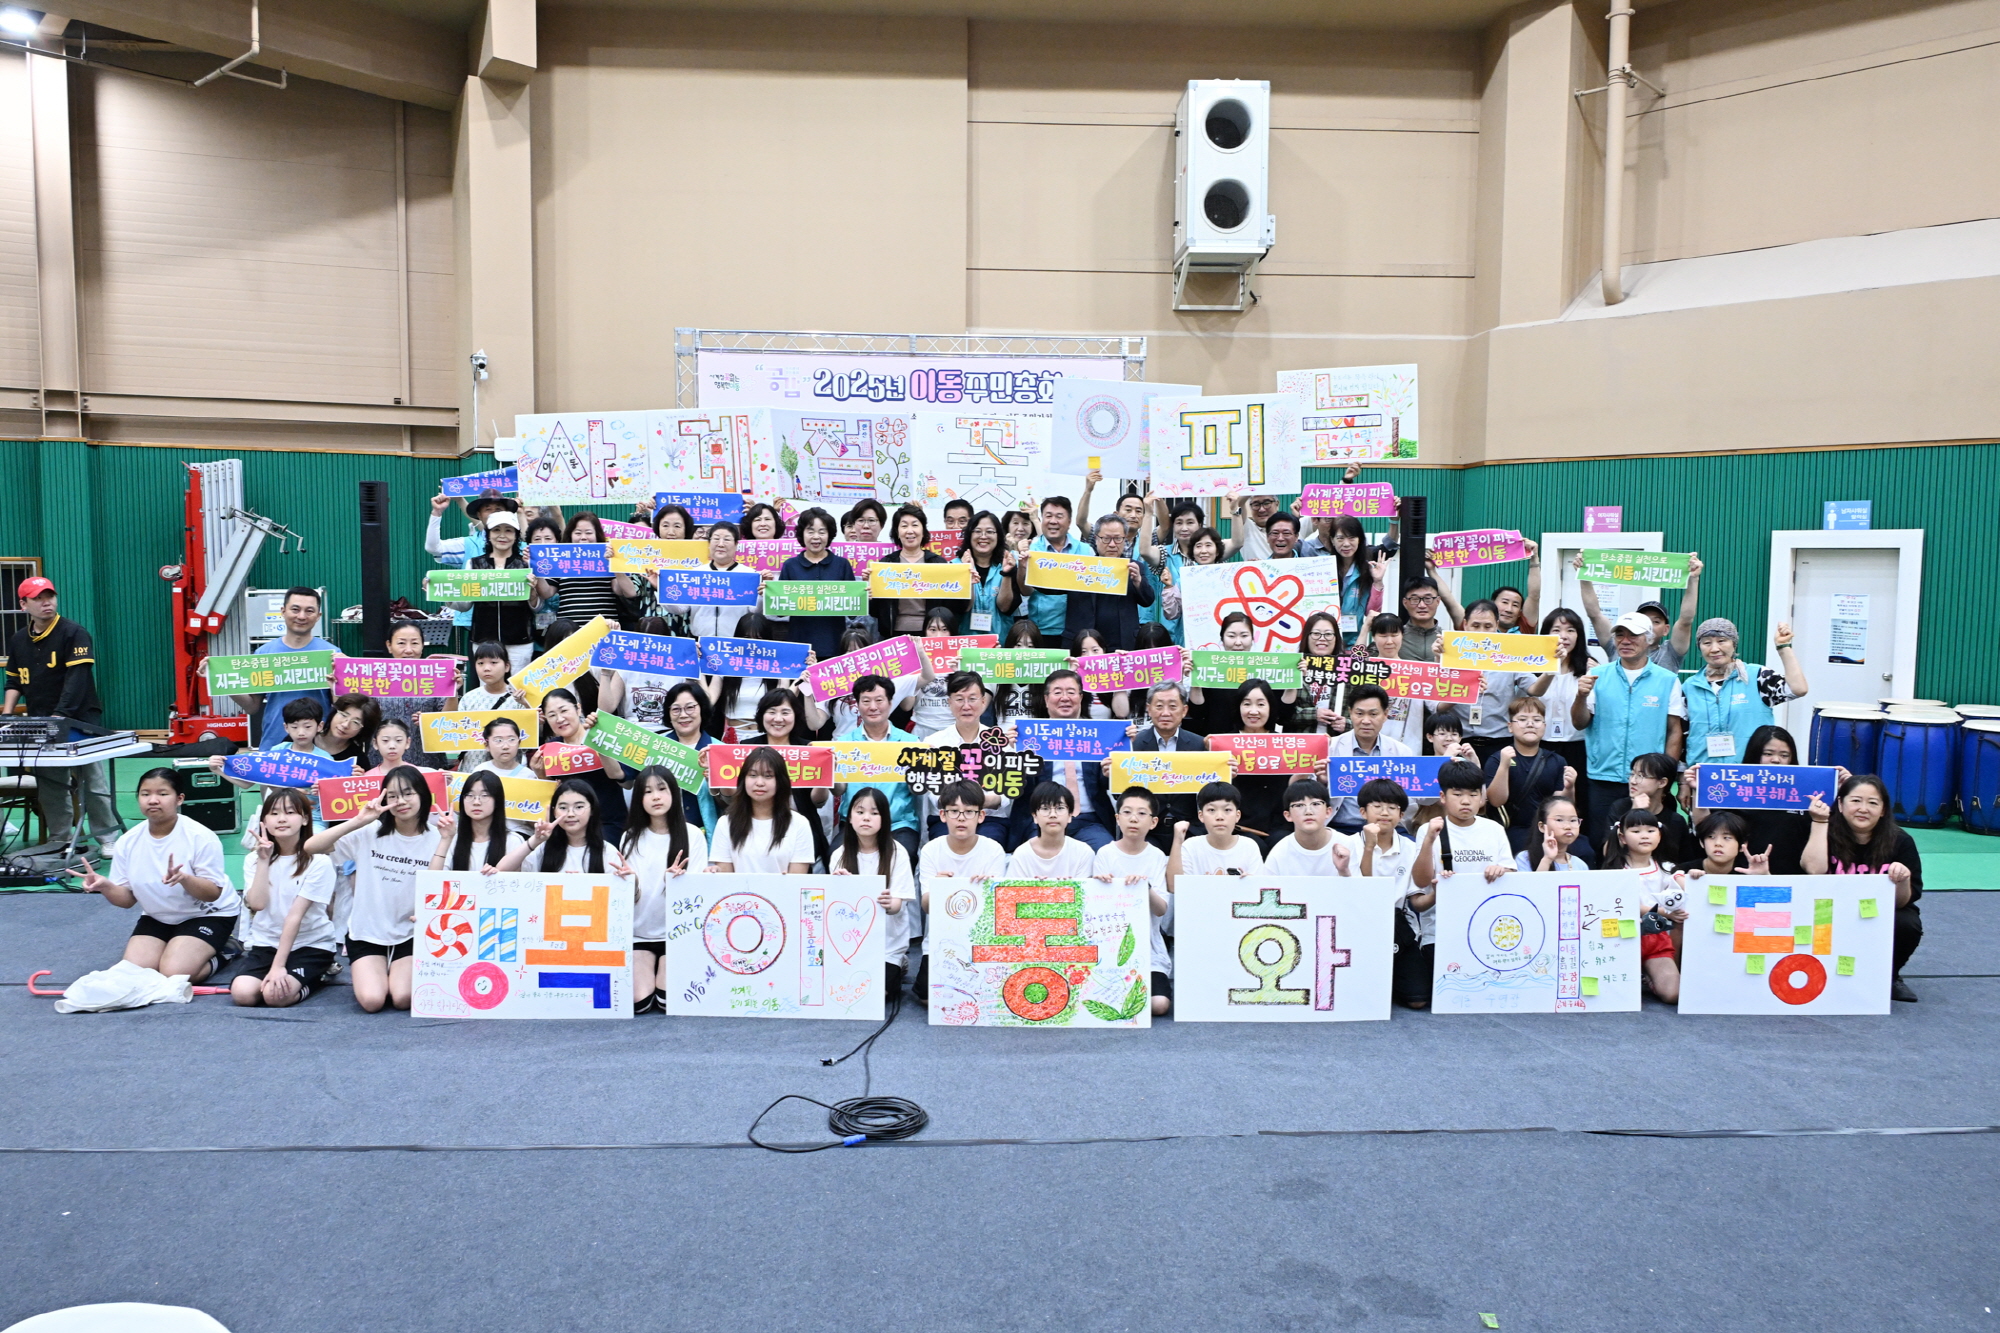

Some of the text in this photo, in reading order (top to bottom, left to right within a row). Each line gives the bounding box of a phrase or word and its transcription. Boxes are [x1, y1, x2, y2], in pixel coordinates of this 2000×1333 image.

[814, 368, 905, 402] 2025년
[1303, 374, 1382, 460] 는
[1180, 403, 1265, 486] 피
[536, 420, 616, 498] 사
[678, 415, 754, 499] 계
[801, 418, 877, 499] 절
[947, 417, 1028, 507] 꽃
[693, 496, 719, 507] 살아서
[1308, 486, 1391, 502] 사계절꽃이 피는
[1307, 499, 1380, 515] 행복한 이동
[1432, 532, 1515, 551] 사계절꽃이 피는
[538, 547, 600, 562] 이동에 살아서
[1431, 545, 1506, 566] 행복한 이동
[1600, 553, 1668, 564] 탄소중립 실천으로
[447, 571, 510, 580] 탄소중립 실천으로
[668, 573, 730, 588] 이동에 살아서
[1584, 564, 1682, 582] 지구는 이동이 지킨다!!
[434, 581, 525, 597] 지구는 이동이 지킨다!!
[687, 587, 755, 601] 행복해요~^^
[783, 584, 846, 594] 탄소중립 실천으로
[770, 596, 861, 611] 지구는 이동이 지킨다!!
[603, 635, 672, 654] 이동에 살아서
[708, 640, 776, 657] 이동에 살아서
[46, 651, 56, 668] J
[231, 656, 309, 669] 탄소중립 실천으로
[623, 652, 696, 671] 행복해요~^^
[728, 656, 801, 673] 행복해요~^^
[818, 639, 909, 679] 사계절꽃이 피는
[980, 652, 1046, 660] 탄소중립 실천으로
[1084, 653, 1174, 674] 사계절꽃이 피는
[1211, 655, 1279, 665] 탄소중립 실천으로
[215, 668, 328, 689] 지구는 이동이 지킨다!!
[344, 663, 447, 682] 사계절꽃이 피는
[995, 663, 1022, 678] 이동이
[1197, 667, 1224, 682] 지구는
[1255, 669, 1294, 684] 지킨다!!
[1390, 663, 1460, 678] 안산의 번영은
[343, 678, 434, 695] 행복한 이동
[1084, 672, 1124, 689] 행복한
[1436, 680, 1468, 698] 부터
[615, 722, 688, 759] 탄소중립 실천으로
[1025, 723, 1098, 741] 이동에 살아서
[591, 729, 654, 766] 지구는 이동이
[1047, 738, 1124, 757] 행복해요~^^
[1233, 736, 1307, 749] 안산의 번영은
[284, 751, 319, 767] 살아서
[898, 750, 956, 771] 사계절
[1340, 760, 1416, 777] 이동에 살아서
[983, 771, 1024, 797] 이동
[1710, 768, 1795, 787] 이동에 살아서
[343, 780, 380, 793] 안산의
[371, 850, 413, 864] You create
[972, 886, 1098, 1021] 동
[1228, 888, 1351, 1011] 화
[1732, 885, 1833, 1005] 팅
